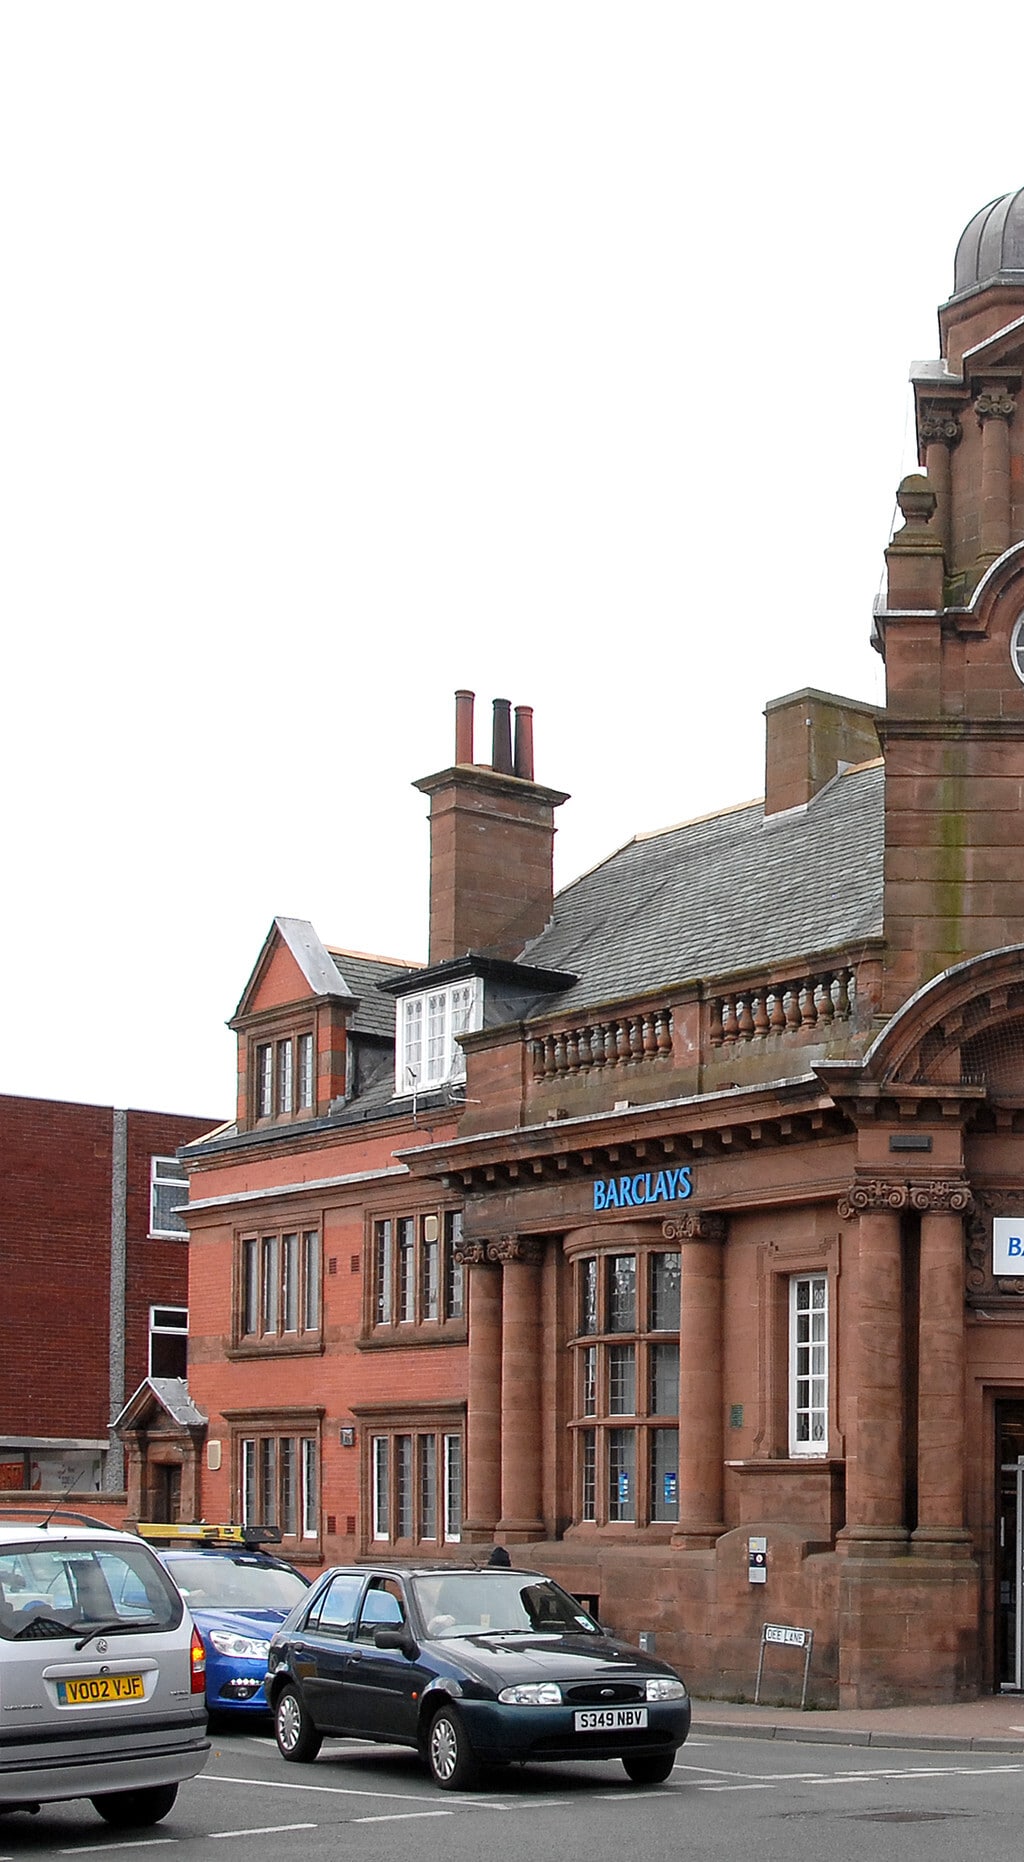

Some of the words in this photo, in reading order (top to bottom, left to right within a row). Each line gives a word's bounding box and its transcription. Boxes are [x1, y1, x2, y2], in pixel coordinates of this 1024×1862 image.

[593, 1167, 692, 1210] BARCLAYS
[767, 1629, 782, 1641] DEE
[784, 1630, 803, 1644] LANE
[111, 1677, 140, 1696] VJF
[580, 1712, 614, 1728] S349
[617, 1711, 642, 1726] NBV
